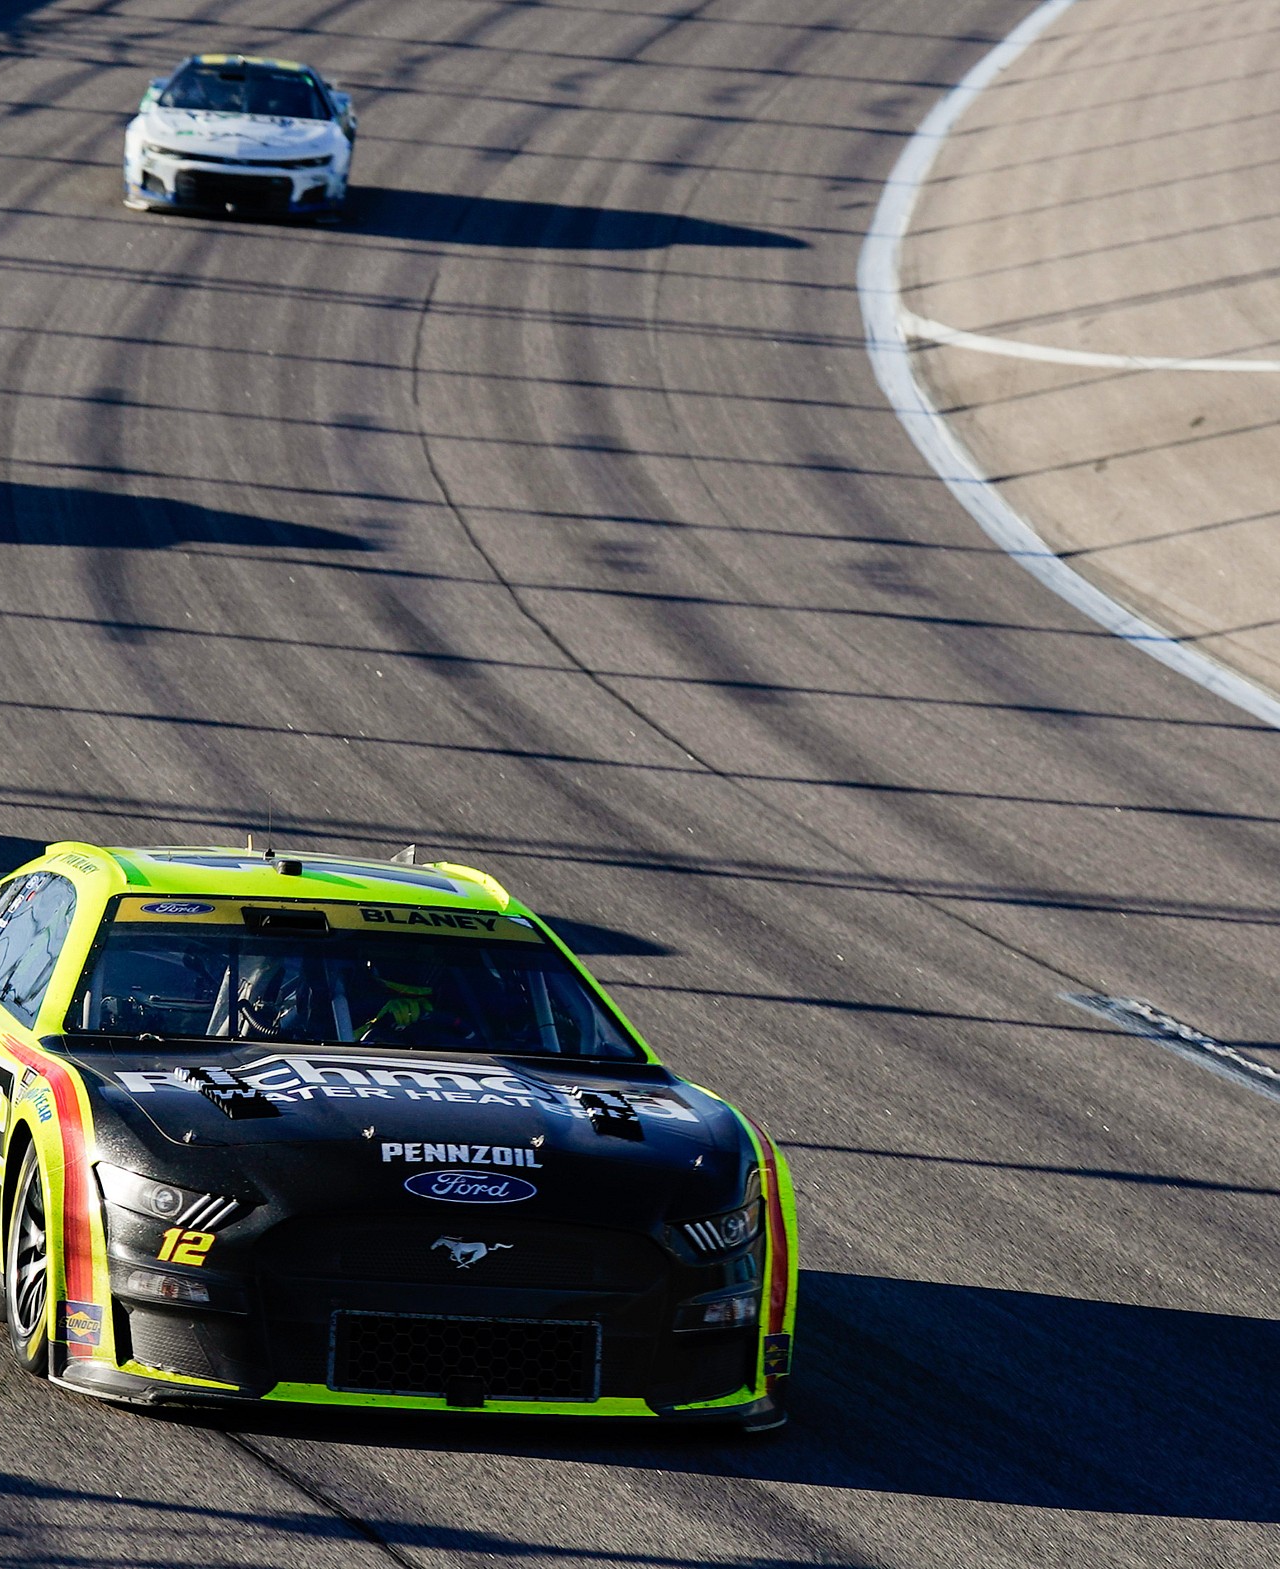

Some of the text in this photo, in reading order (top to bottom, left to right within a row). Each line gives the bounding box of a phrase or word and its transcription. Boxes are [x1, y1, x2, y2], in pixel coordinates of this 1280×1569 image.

[154, 902, 203, 915] Ford
[360, 907, 498, 932] BLANEY
[114, 1058, 700, 1122] Richmond
[210, 1085, 396, 1102] WATER
[22, 1088, 53, 1124] YEAR
[381, 1142, 544, 1169] PENNZOIL
[431, 1172, 510, 1198] Ford
[157, 1227, 216, 1266] 12
[58, 1316, 100, 1333] SUNOCO
